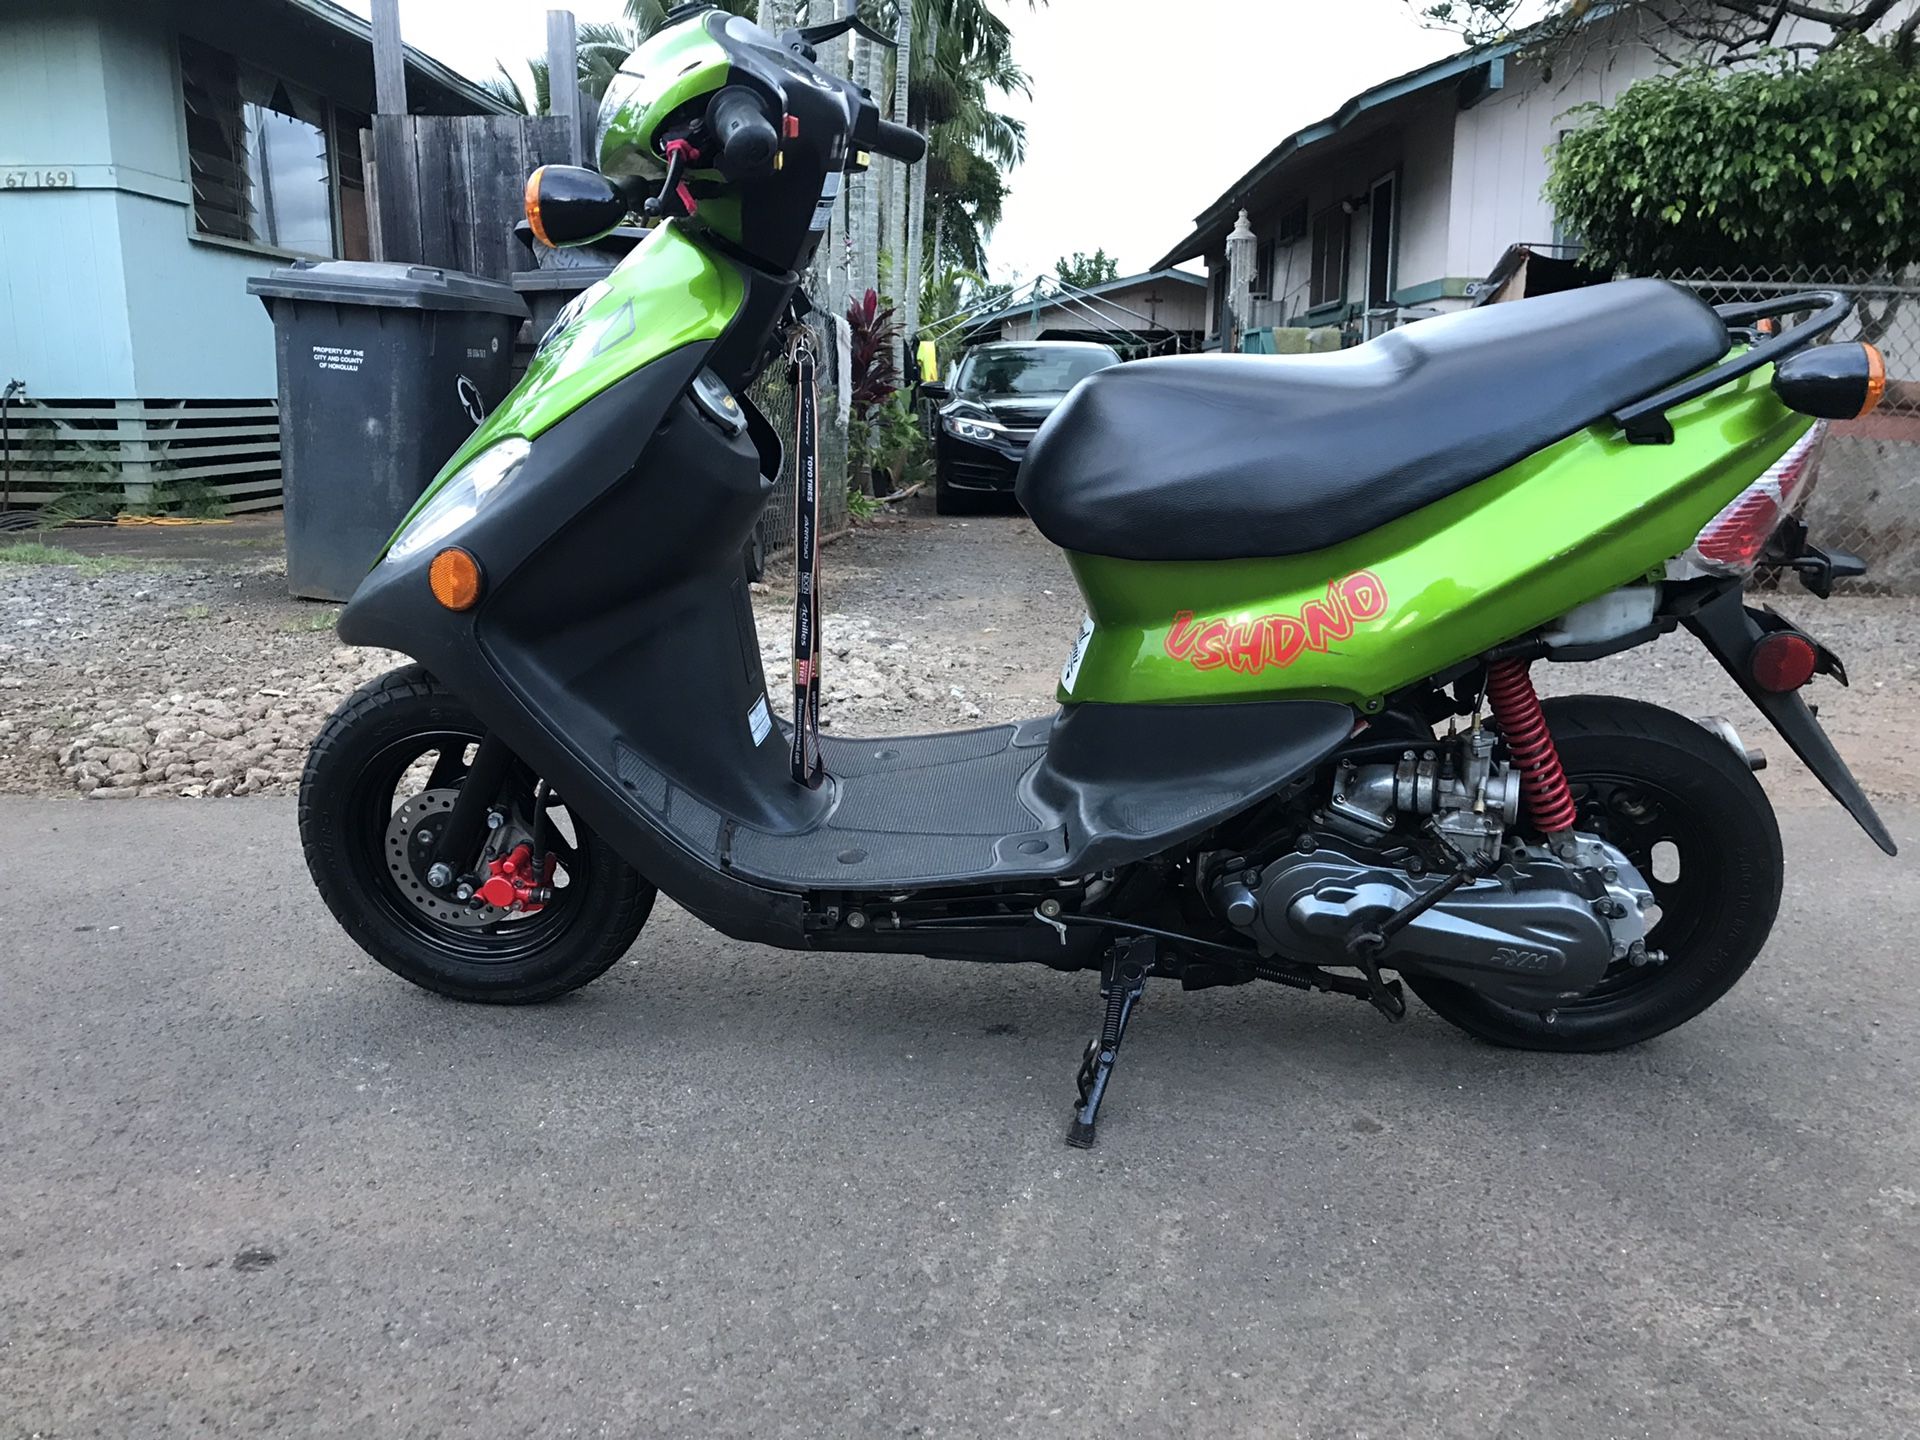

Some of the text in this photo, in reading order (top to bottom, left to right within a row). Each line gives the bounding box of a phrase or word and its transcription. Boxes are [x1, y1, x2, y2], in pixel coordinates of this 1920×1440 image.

[312, 346, 343, 355] PROPERTY
[340, 356, 364, 364] COUNTY
[327, 363, 358, 372] HONOLULU
[801, 602, 809, 647] Achilles
[1490, 947, 1548, 970] SYM
